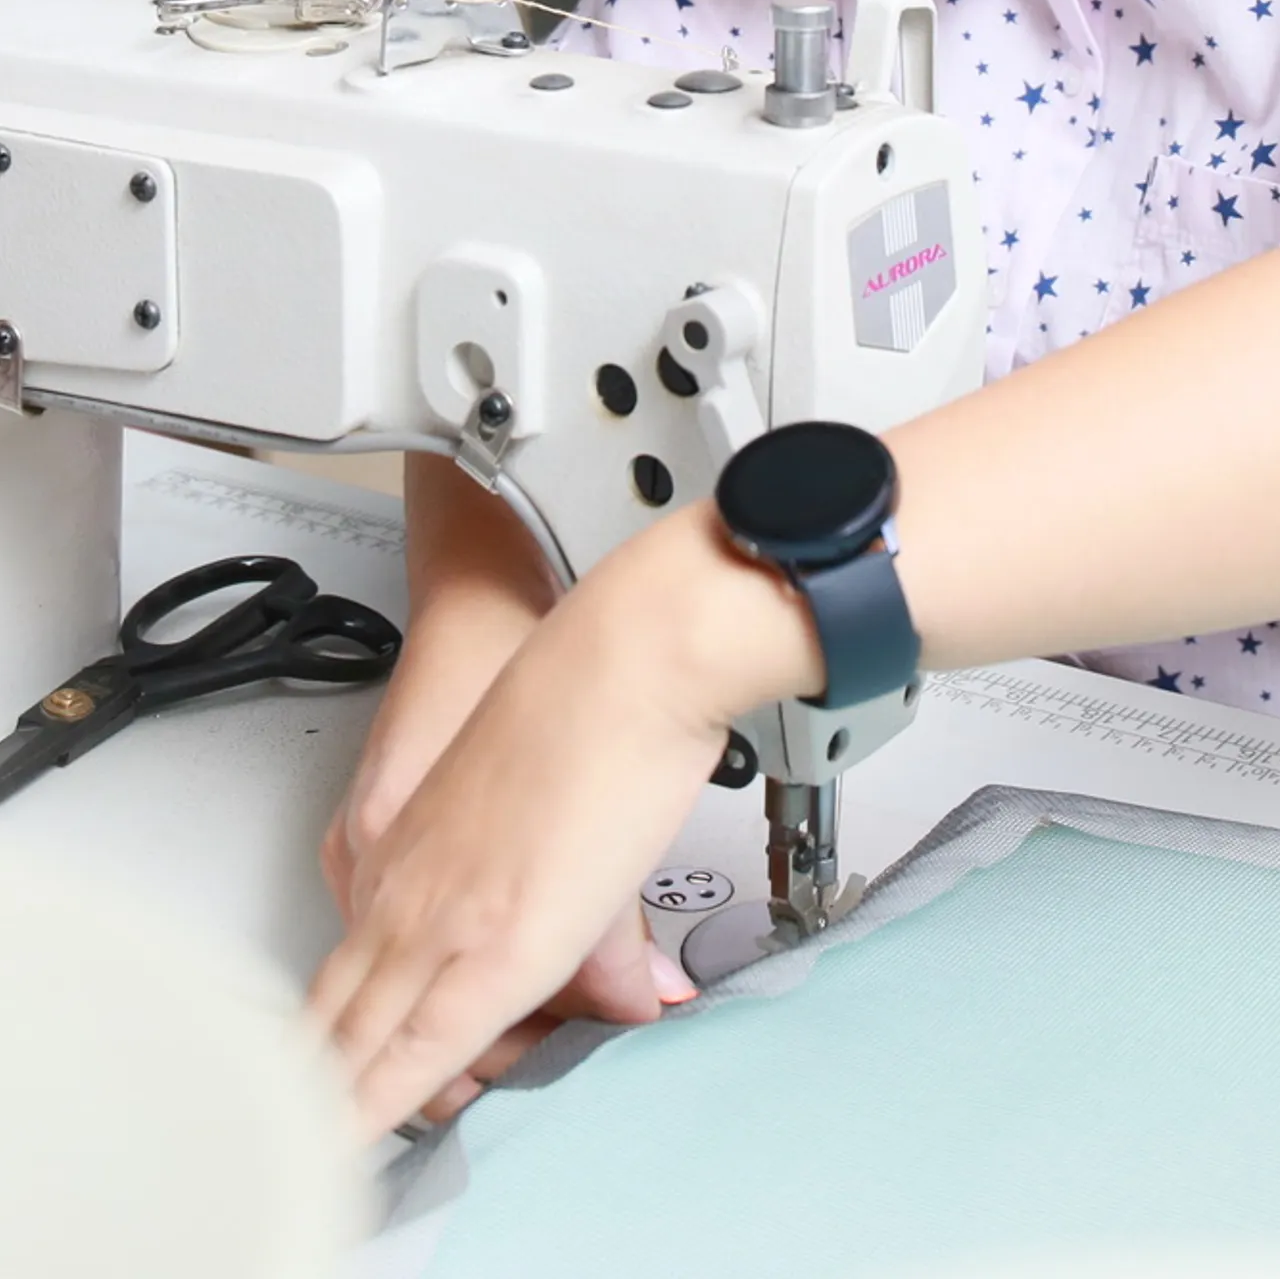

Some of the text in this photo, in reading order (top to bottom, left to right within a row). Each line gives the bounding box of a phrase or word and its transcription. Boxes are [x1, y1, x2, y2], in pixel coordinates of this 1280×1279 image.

[863, 243, 947, 299] AURORA
[1006, 689, 1036, 704] 19
[1080, 708, 1114, 724] 18
[1157, 728, 1191, 744] 17
[1237, 748, 1270, 764] 16
